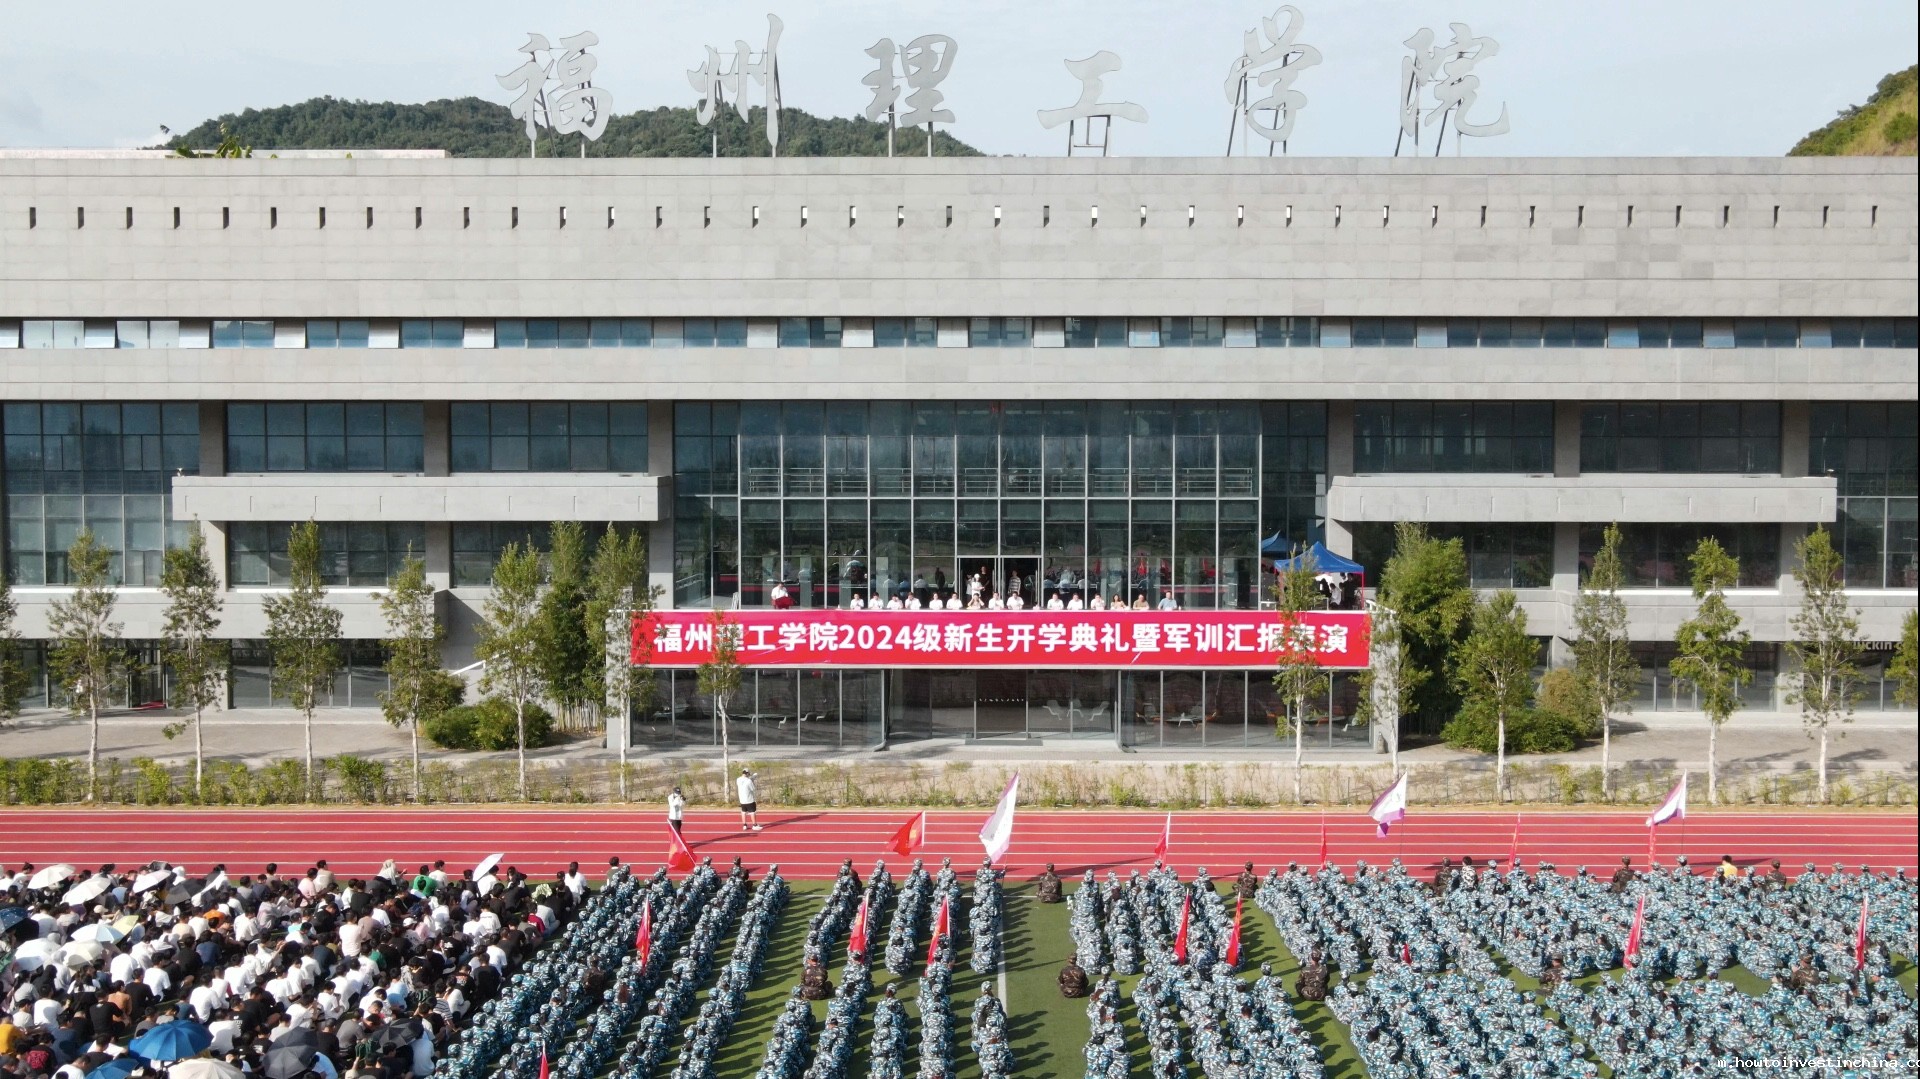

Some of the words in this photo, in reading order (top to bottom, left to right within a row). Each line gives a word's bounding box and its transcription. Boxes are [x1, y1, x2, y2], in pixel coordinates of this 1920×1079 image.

[496, 5, 1510, 147] 福州理工学院
